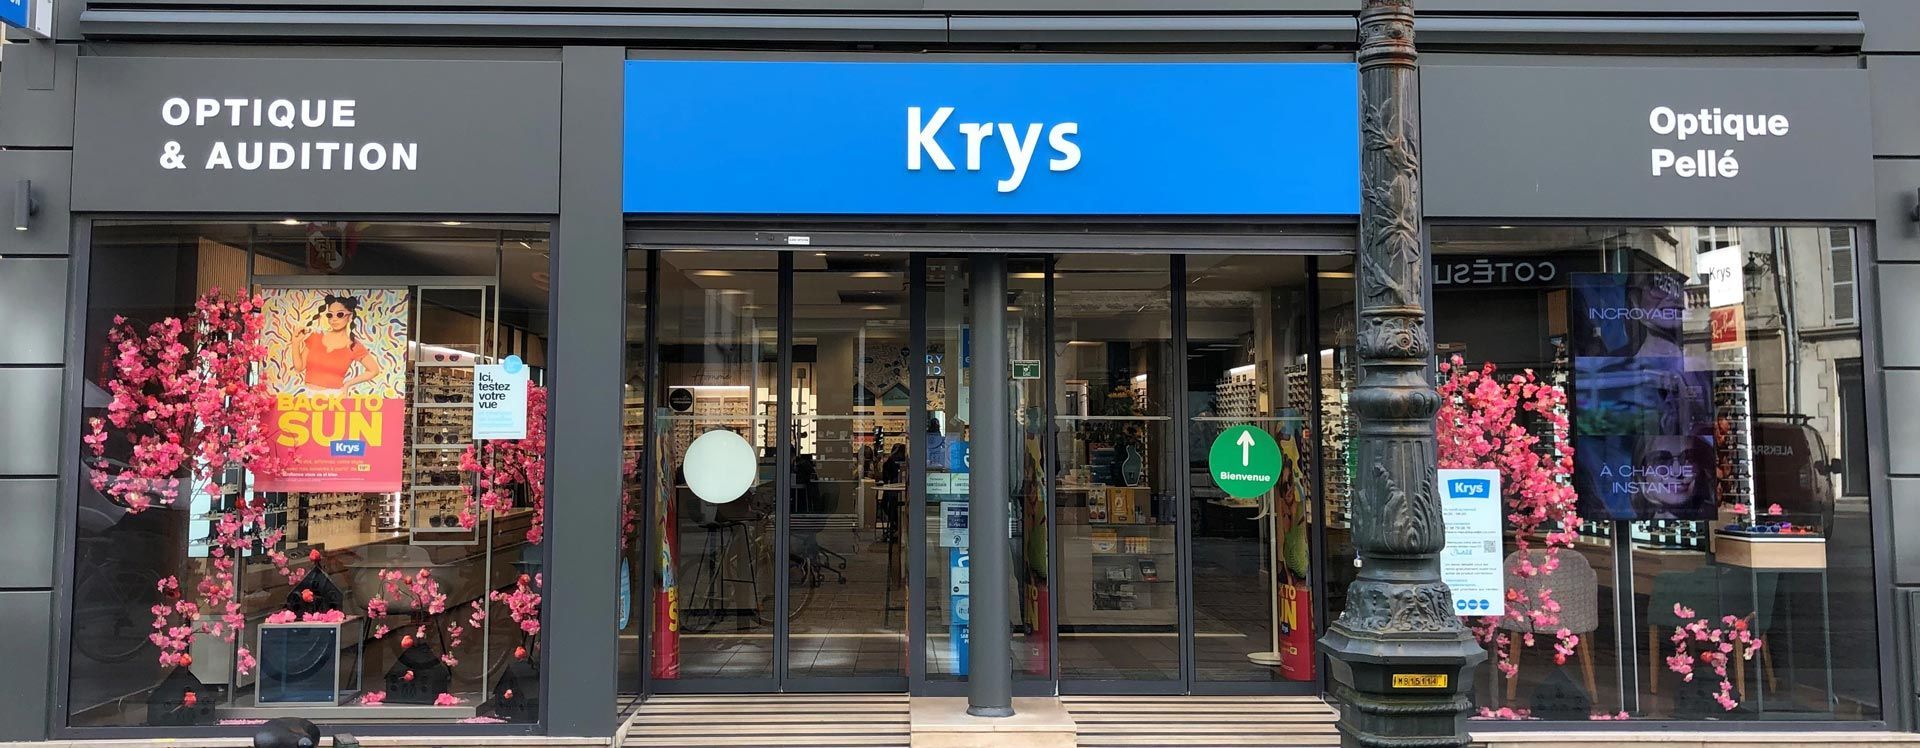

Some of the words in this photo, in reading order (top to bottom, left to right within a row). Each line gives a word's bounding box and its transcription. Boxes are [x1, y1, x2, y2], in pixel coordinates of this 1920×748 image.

[162, 97, 356, 130] OPTIQUE
[1649, 106, 1790, 141] Optique
[159, 140, 187, 169] &
[205, 141, 418, 171] AUDITION
[907, 106, 1082, 194] Krys
[1651, 148, 1739, 178] Pellé
[1709, 266, 1731, 282] Krys
[1589, 307, 1693, 321] INCROYABLE
[479, 372, 494, 383] Ici,
[478, 383, 511, 391] testez
[277, 394, 347, 412] BACK
[352, 393, 384, 412] TO
[479, 392, 506, 401] votre
[479, 401, 498, 409] vue
[276, 411, 384, 447] SUN
[335, 443, 360, 454] Krys
[1220, 471, 1271, 482] Bienvenue
[1618, 465, 1694, 479] CHAQUE
[1455, 482, 1484, 495] Krys
[1612, 482, 1683, 494] INSTANT
